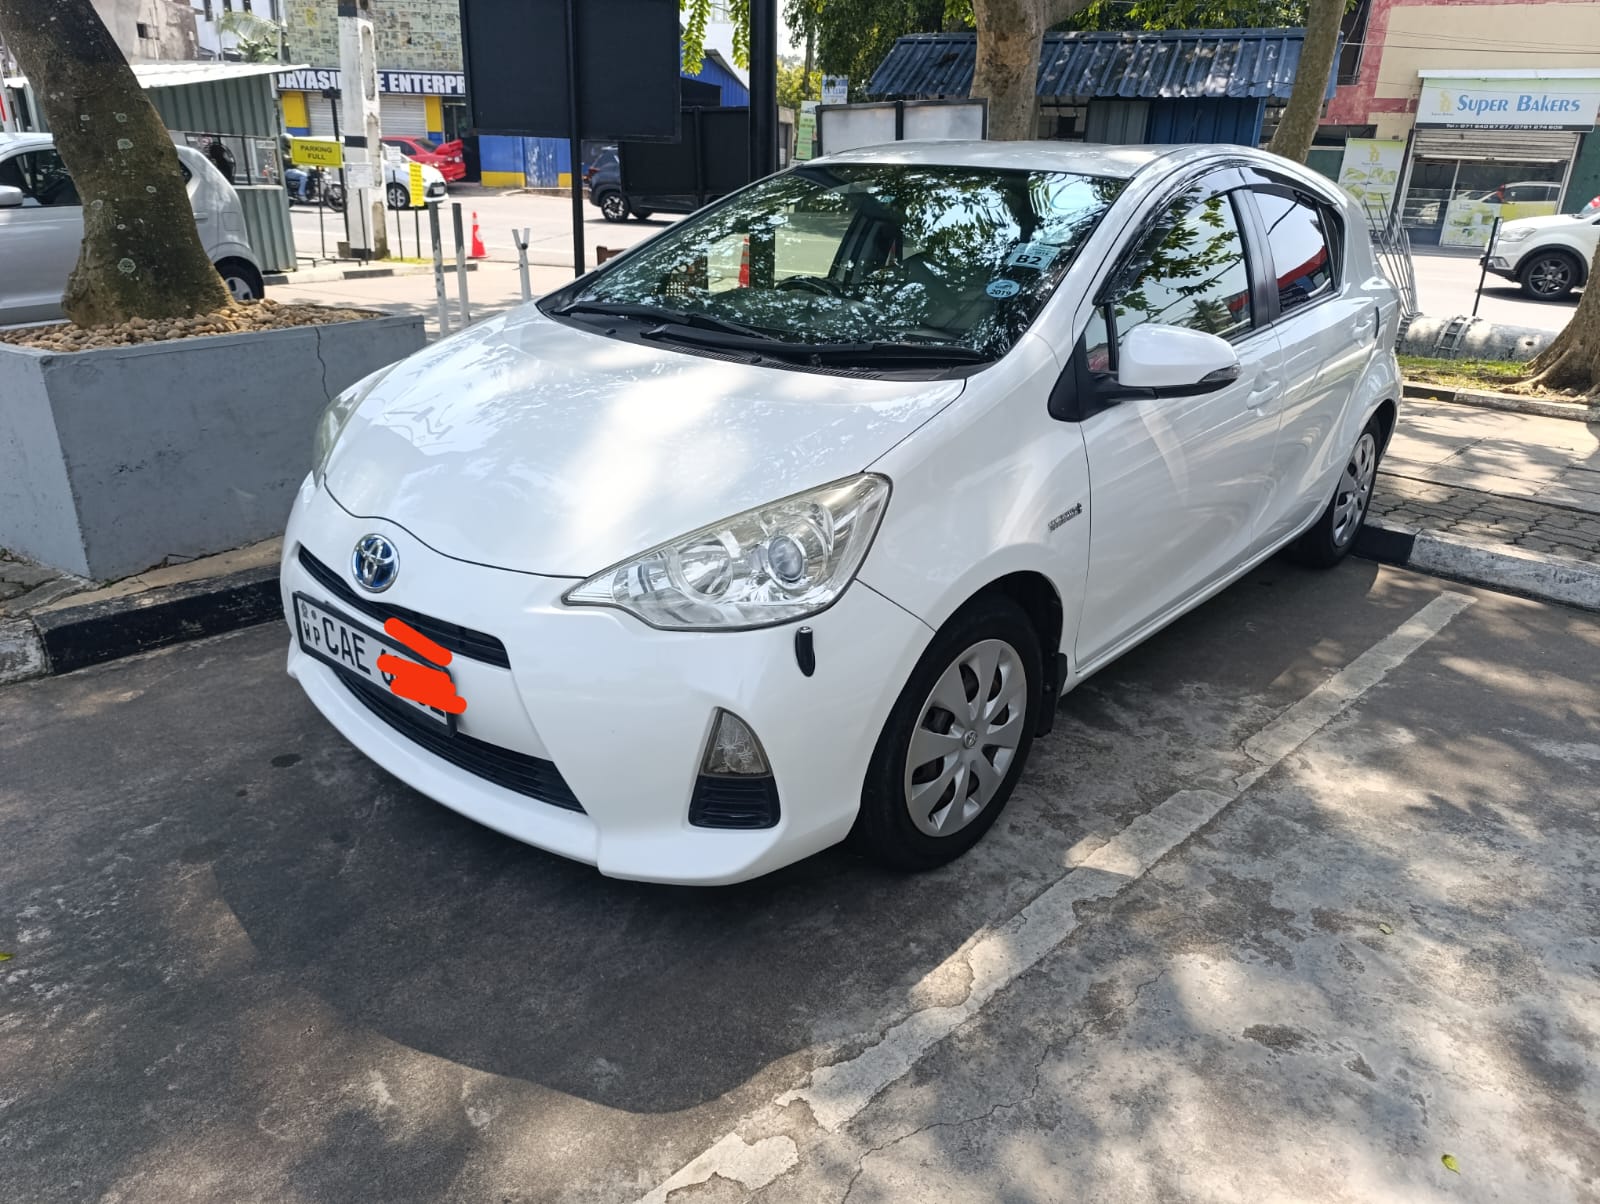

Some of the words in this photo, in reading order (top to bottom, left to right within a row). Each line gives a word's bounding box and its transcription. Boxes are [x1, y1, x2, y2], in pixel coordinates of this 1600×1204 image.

[300, 145, 332, 153] PARKING
[1015, 254, 1042, 265] B2
[322, 617, 371, 675] CAE
